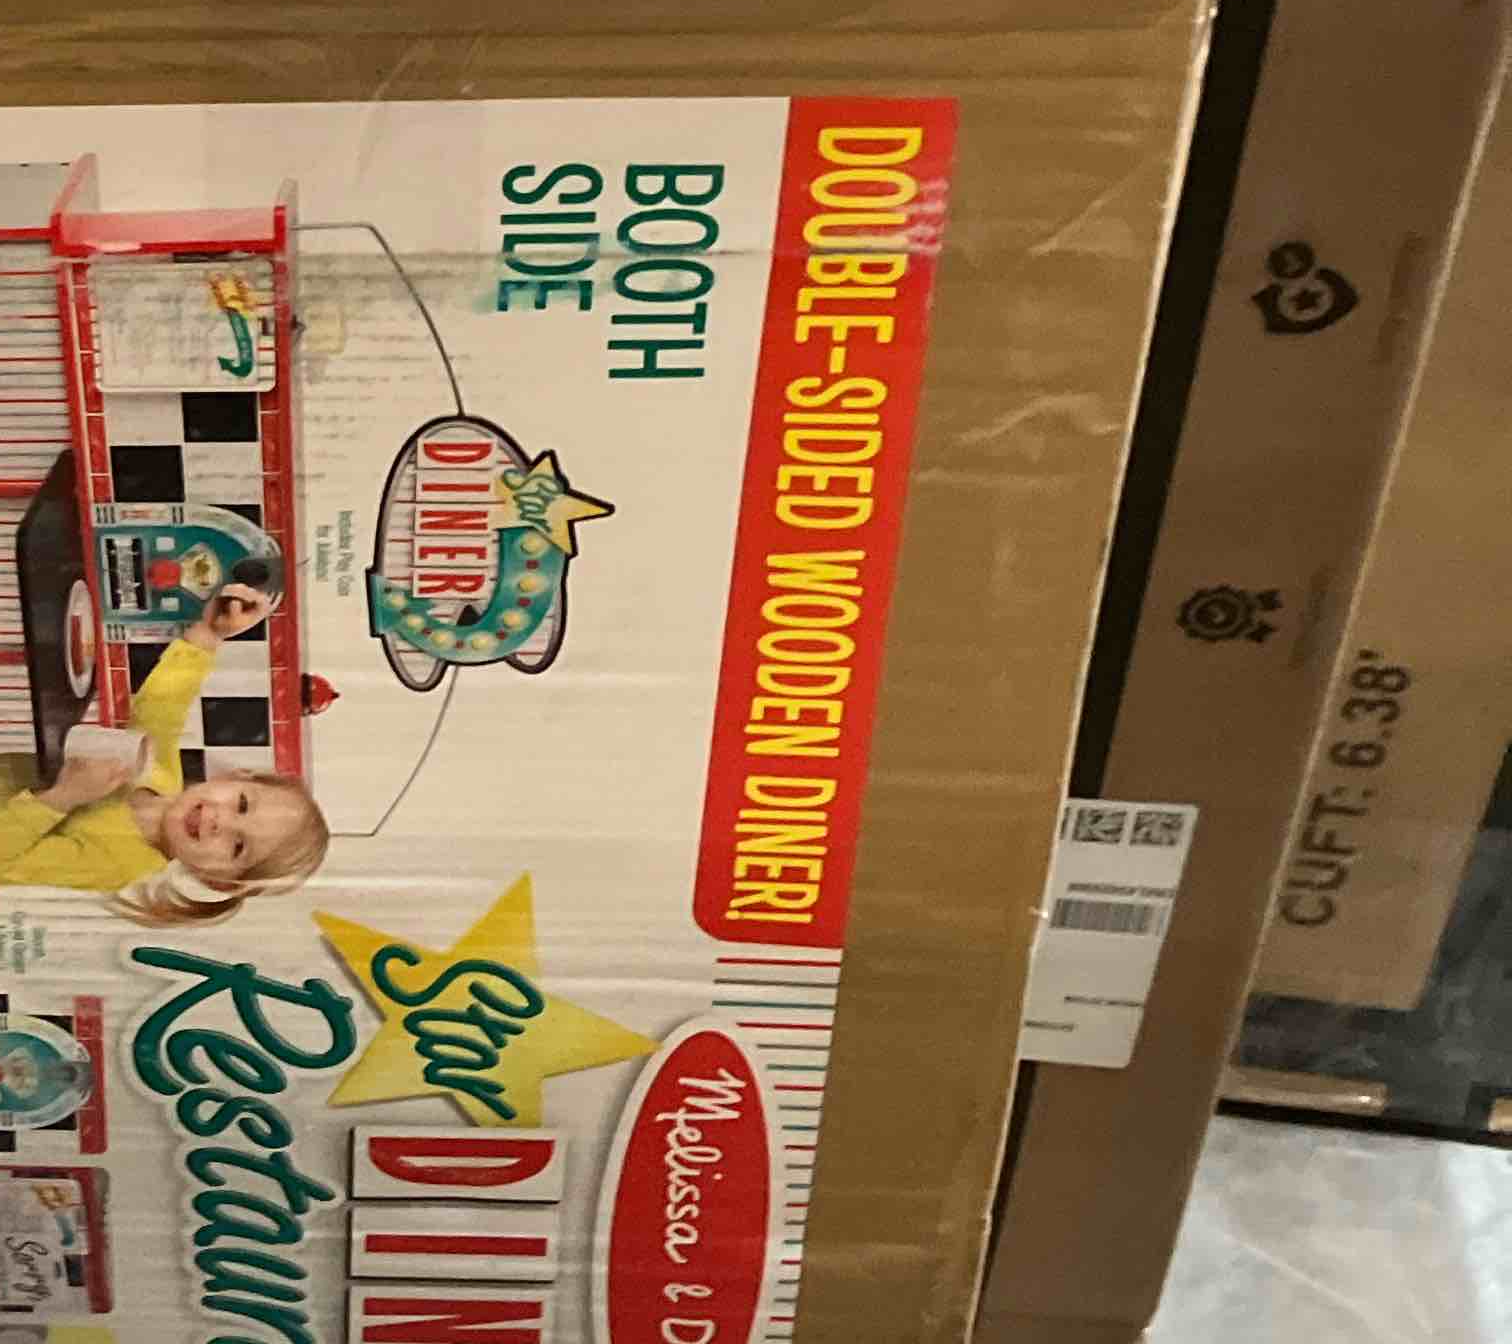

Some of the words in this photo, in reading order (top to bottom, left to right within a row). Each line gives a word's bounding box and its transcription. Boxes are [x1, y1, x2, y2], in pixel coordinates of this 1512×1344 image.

[496, 161, 603, 313] SIDE
[607, 162, 726, 381] BOOTH
[776, 127, 923, 528] DOUBLE-SIDED
[414, 440, 493, 596] DINER
[498, 468, 561, 530] Star
[744, 548, 867, 757] WOODEN
[726, 775, 838, 923] DINER!
[1279, 786, 1378, 931] CUFT:
[370, 943, 545, 1121] Star
[654, 1067, 747, 1264] Melissa
[676, 1281, 713, 1301] &
